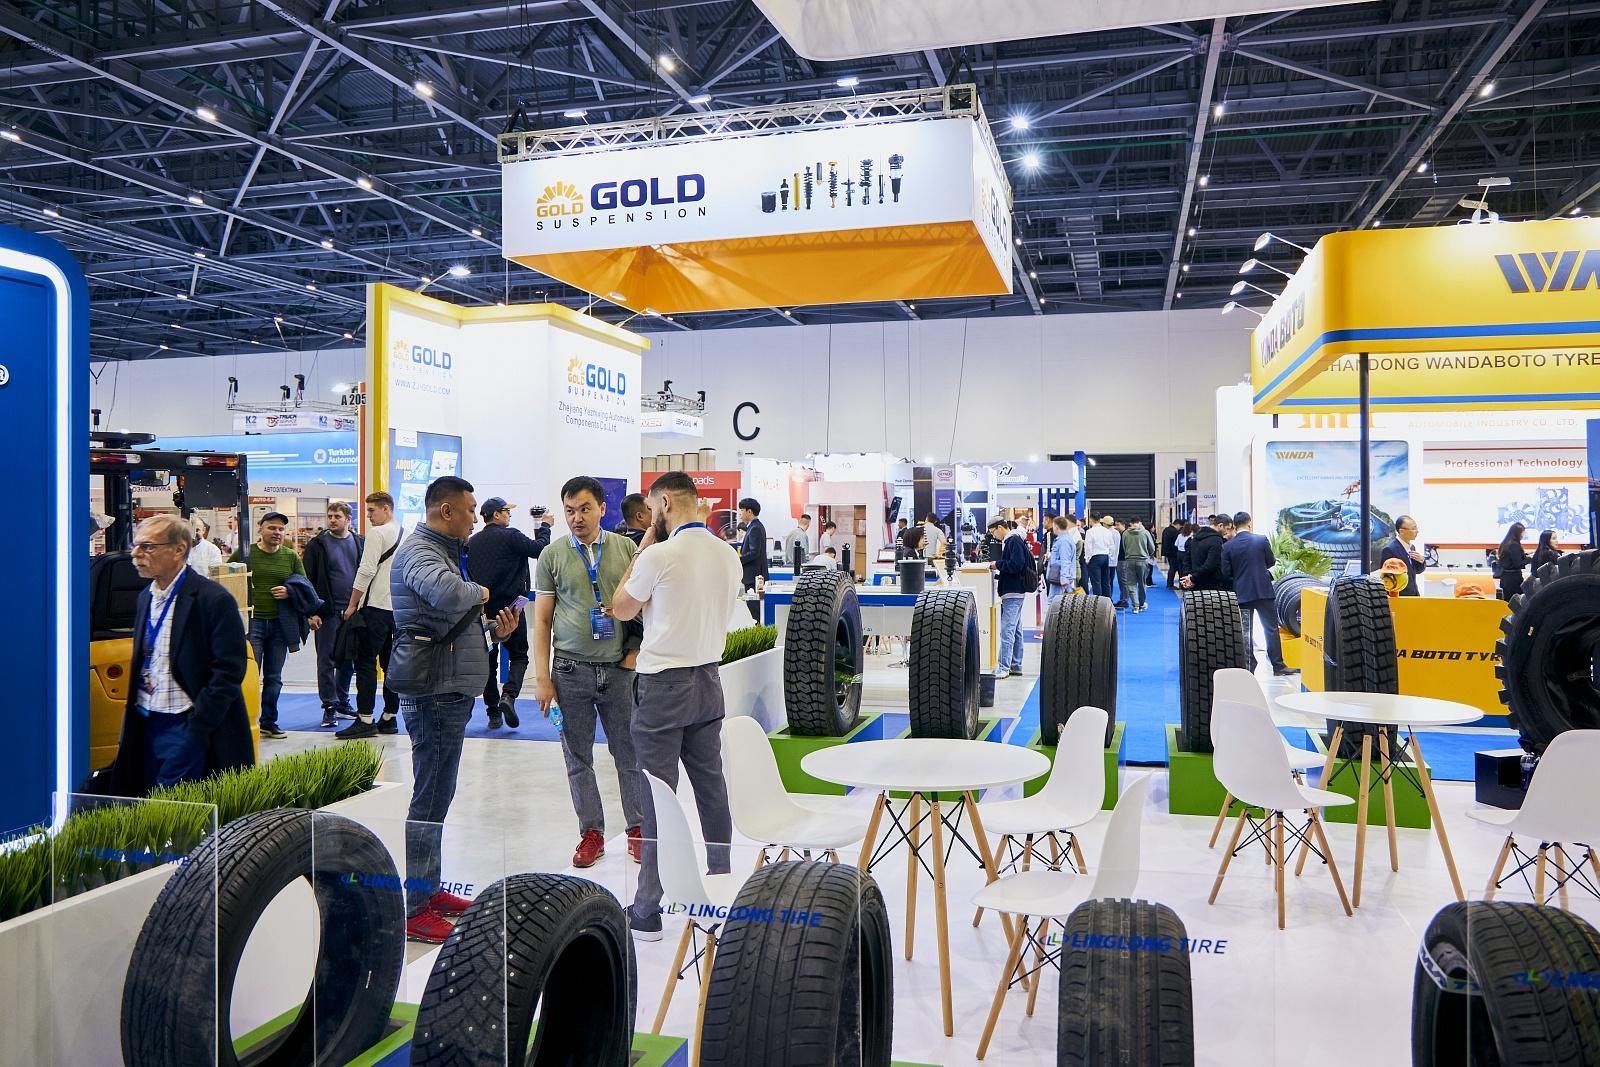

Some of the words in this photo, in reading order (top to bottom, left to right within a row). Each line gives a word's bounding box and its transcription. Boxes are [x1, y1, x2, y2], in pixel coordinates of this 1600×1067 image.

[590, 173, 706, 211] GOLD
[536, 202, 584, 218] GOLD
[536, 206, 707, 231] SUSPENSION
[412, 344, 452, 370] GOLD
[1426, 354, 1546, 369] WANDABOTO
[1552, 352, 1600, 366] TYRE
[567, 373, 585, 385] GOLD
[586, 363, 626, 396] GOLD
[341, 395, 348, 406] A
[349, 393, 366, 406] 205
[245, 415, 257, 424] K2
[733, 401, 760, 441] C
[328, 448, 355, 457] Turkish
[1444, 459, 1513, 468] Professional
[1517, 458, 1584, 469] Technology
[131, 485, 172, 493] ОЭЛЕКТРИКА
[1410, 650, 1460, 661] BOTO
[1466, 652, 1503, 662] TYR
[440, 881, 474, 896] TIRE
[688, 903, 774, 924] LINGLONG
[780, 910, 823, 928] TIRE
[1071, 933, 1174, 953] LINGLONG
[1180, 938, 1228, 954] TIRE
